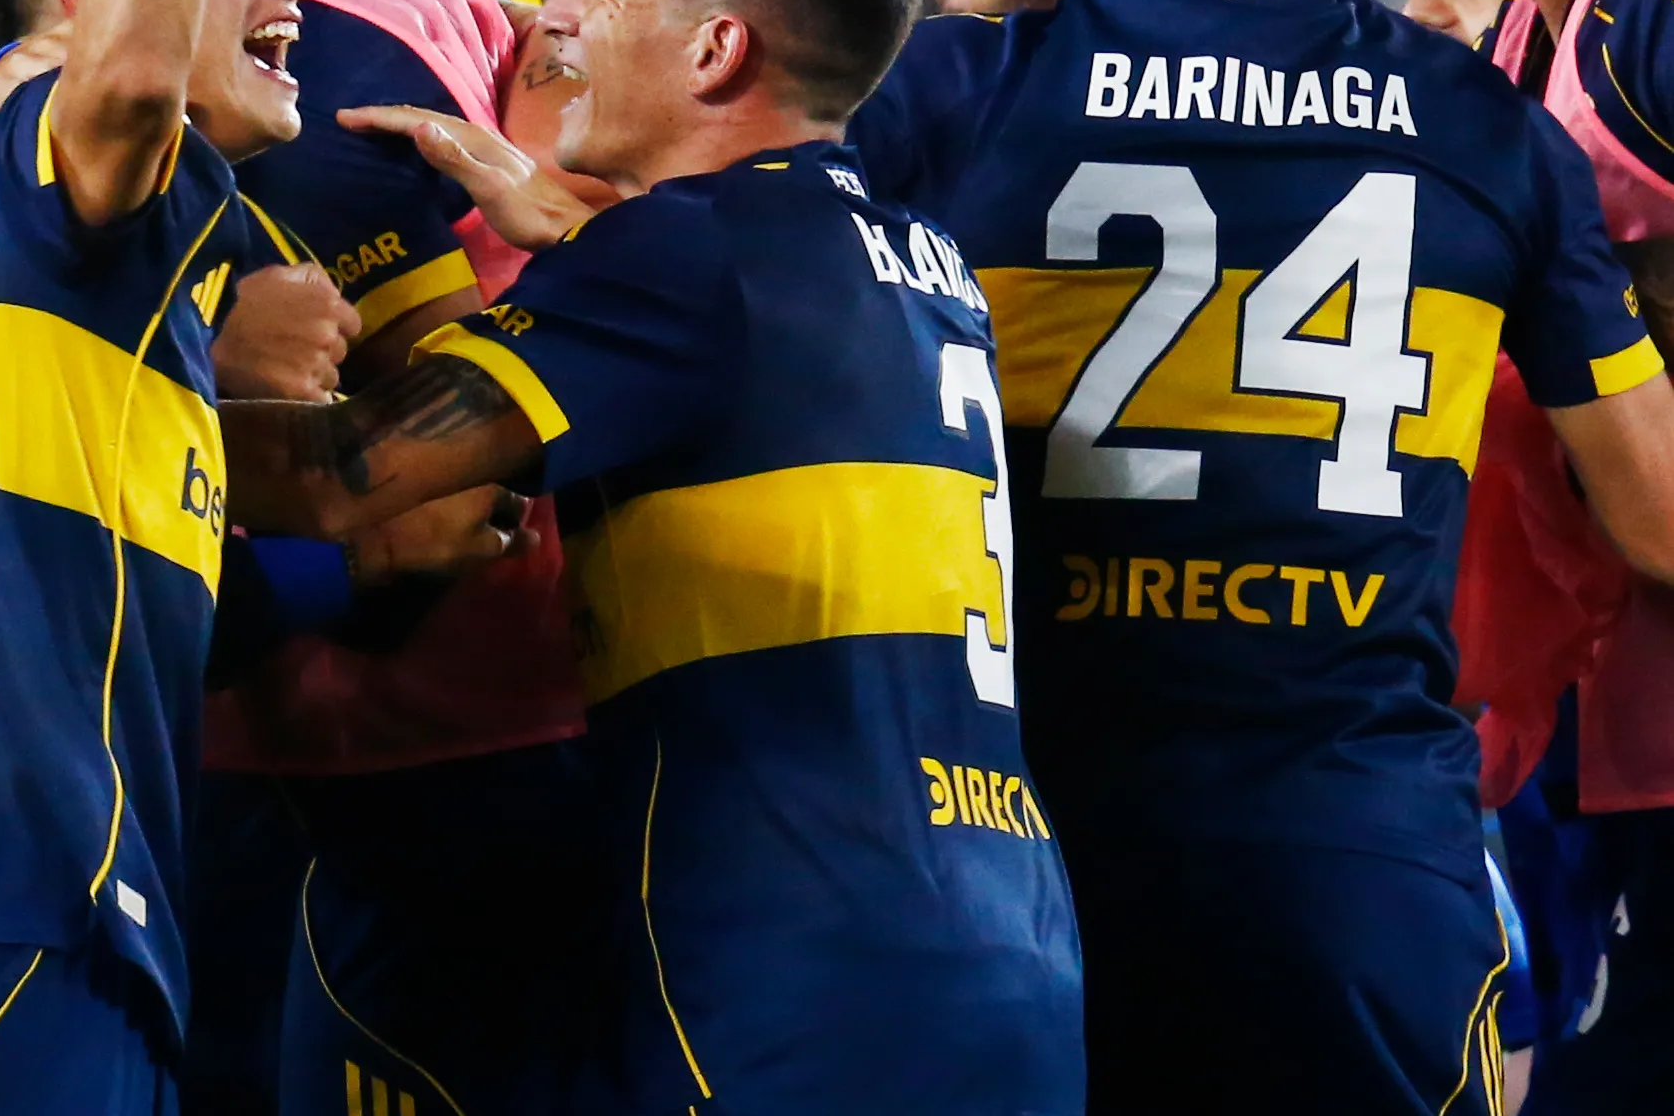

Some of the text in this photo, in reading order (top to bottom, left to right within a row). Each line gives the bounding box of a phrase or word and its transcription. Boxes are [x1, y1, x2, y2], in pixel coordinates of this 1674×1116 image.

[1084, 52, 1418, 137] BARINAGA
[1040, 160, 1428, 519] 24
[939, 341, 1015, 709] 3
[1055, 553, 1386, 629] DIRECTV
